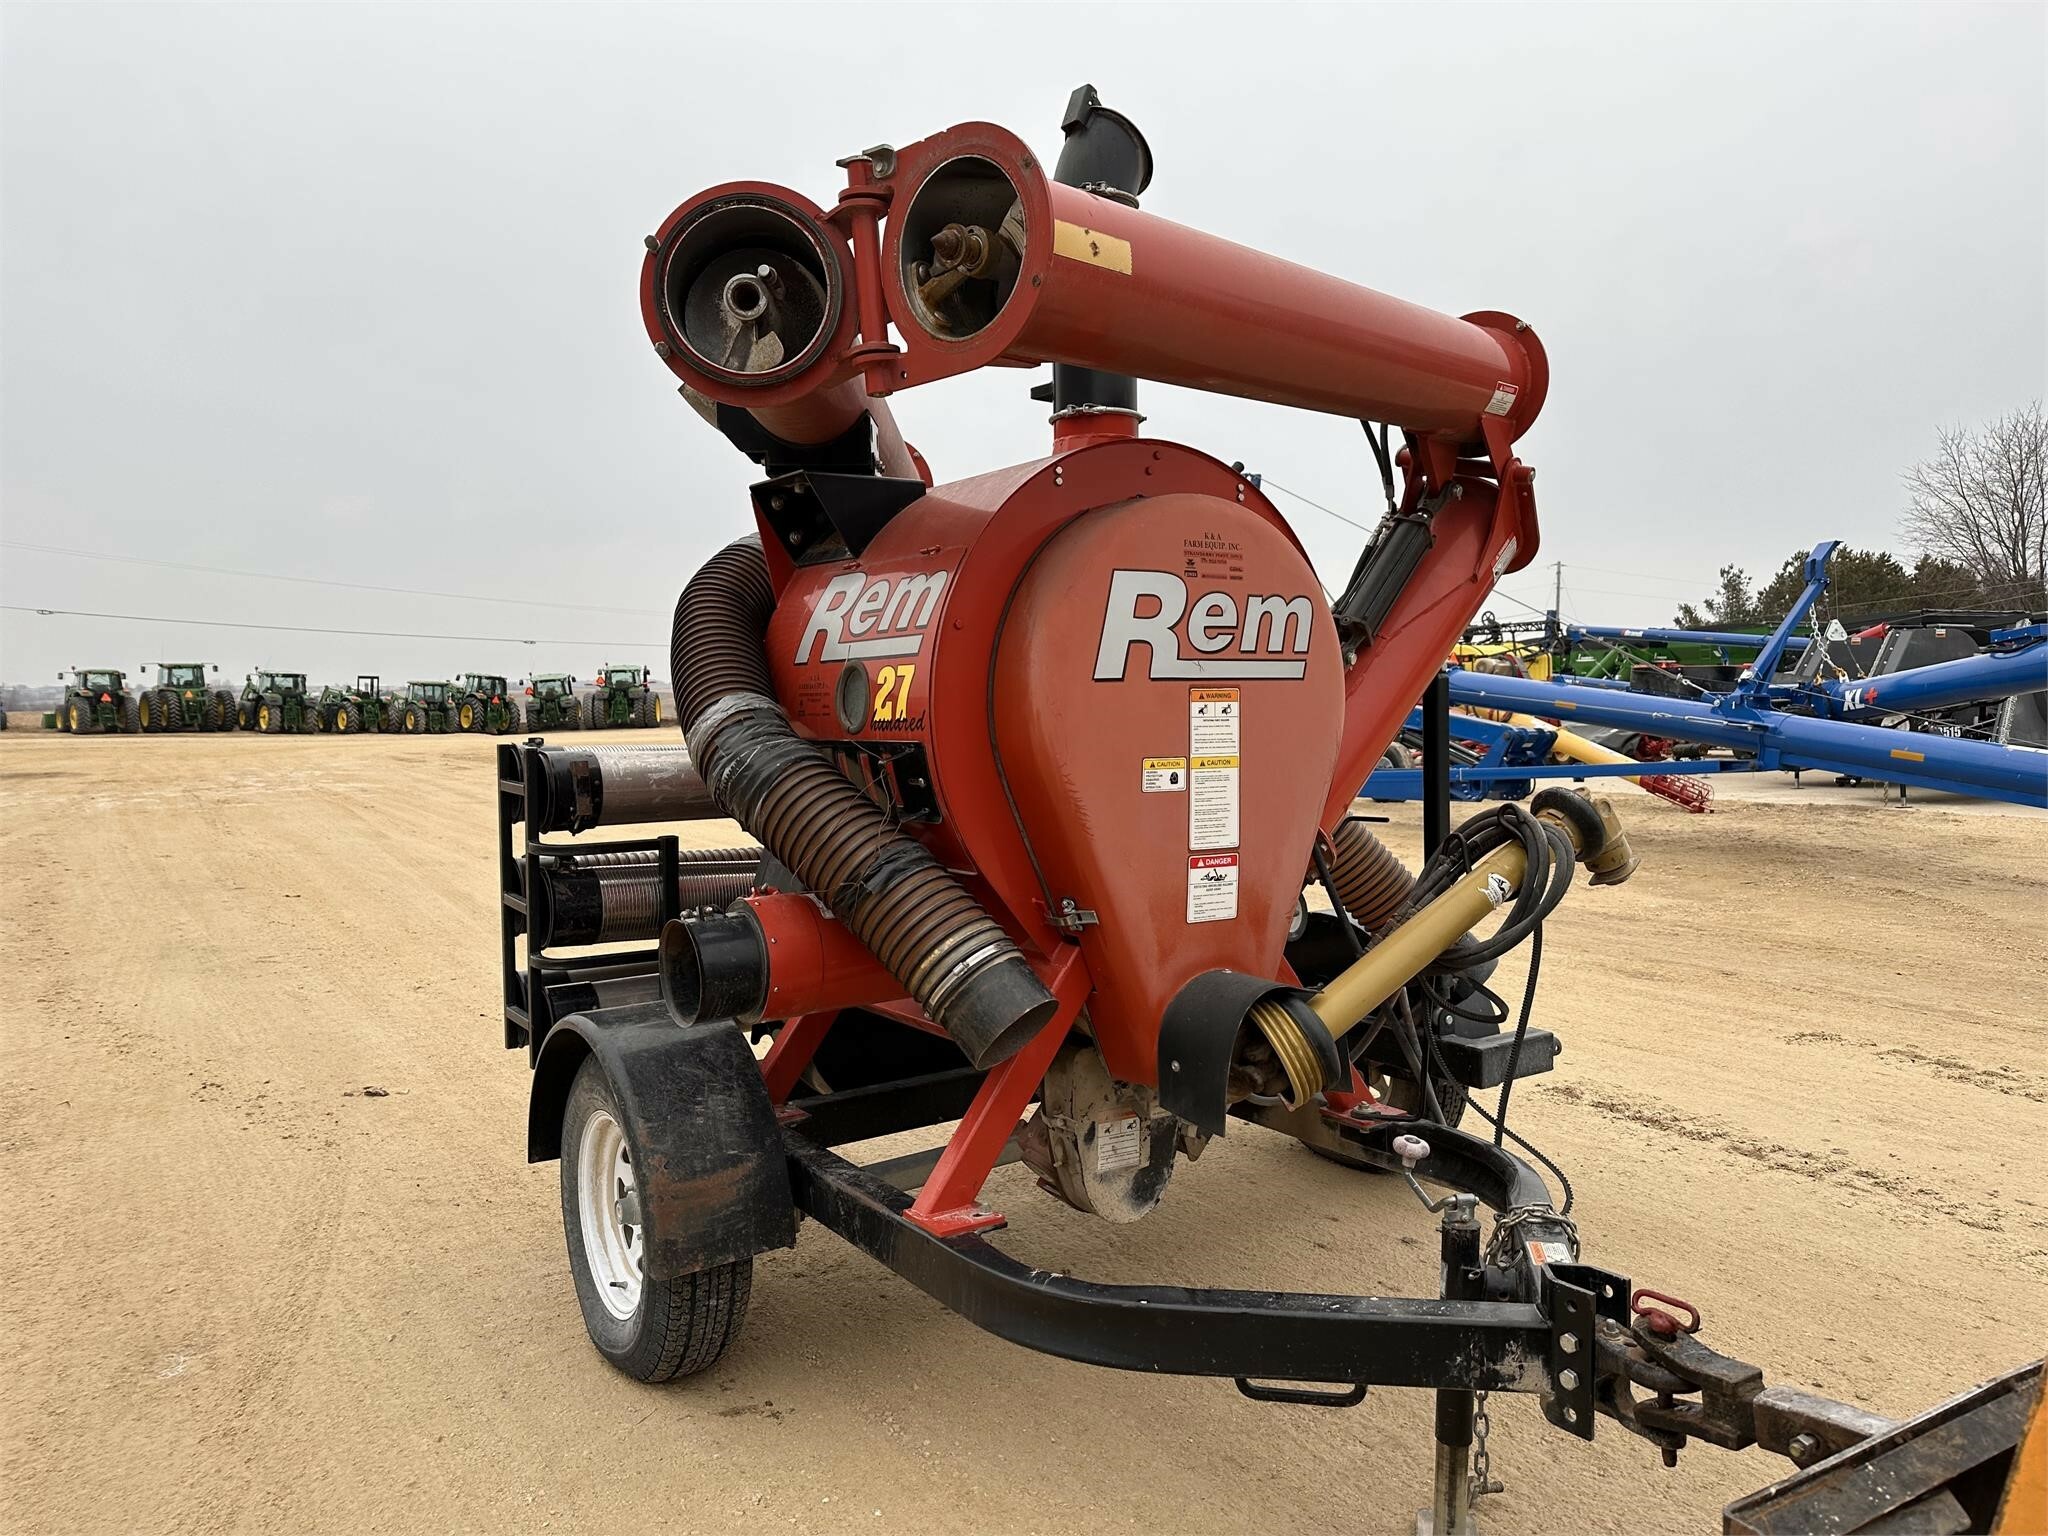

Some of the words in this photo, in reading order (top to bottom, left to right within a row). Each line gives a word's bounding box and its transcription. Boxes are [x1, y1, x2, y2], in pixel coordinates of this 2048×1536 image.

[1184, 539, 1204, 548] FARM
[1204, 532, 1210, 540] K
[1216, 533, 1222, 541] A
[793, 570, 949, 667] Rem
[1092, 568, 1315, 682] Rem
[873, 664, 916, 721] 27
[871, 708, 927, 731] hundred
[1205, 857, 1232, 866] DANGER
